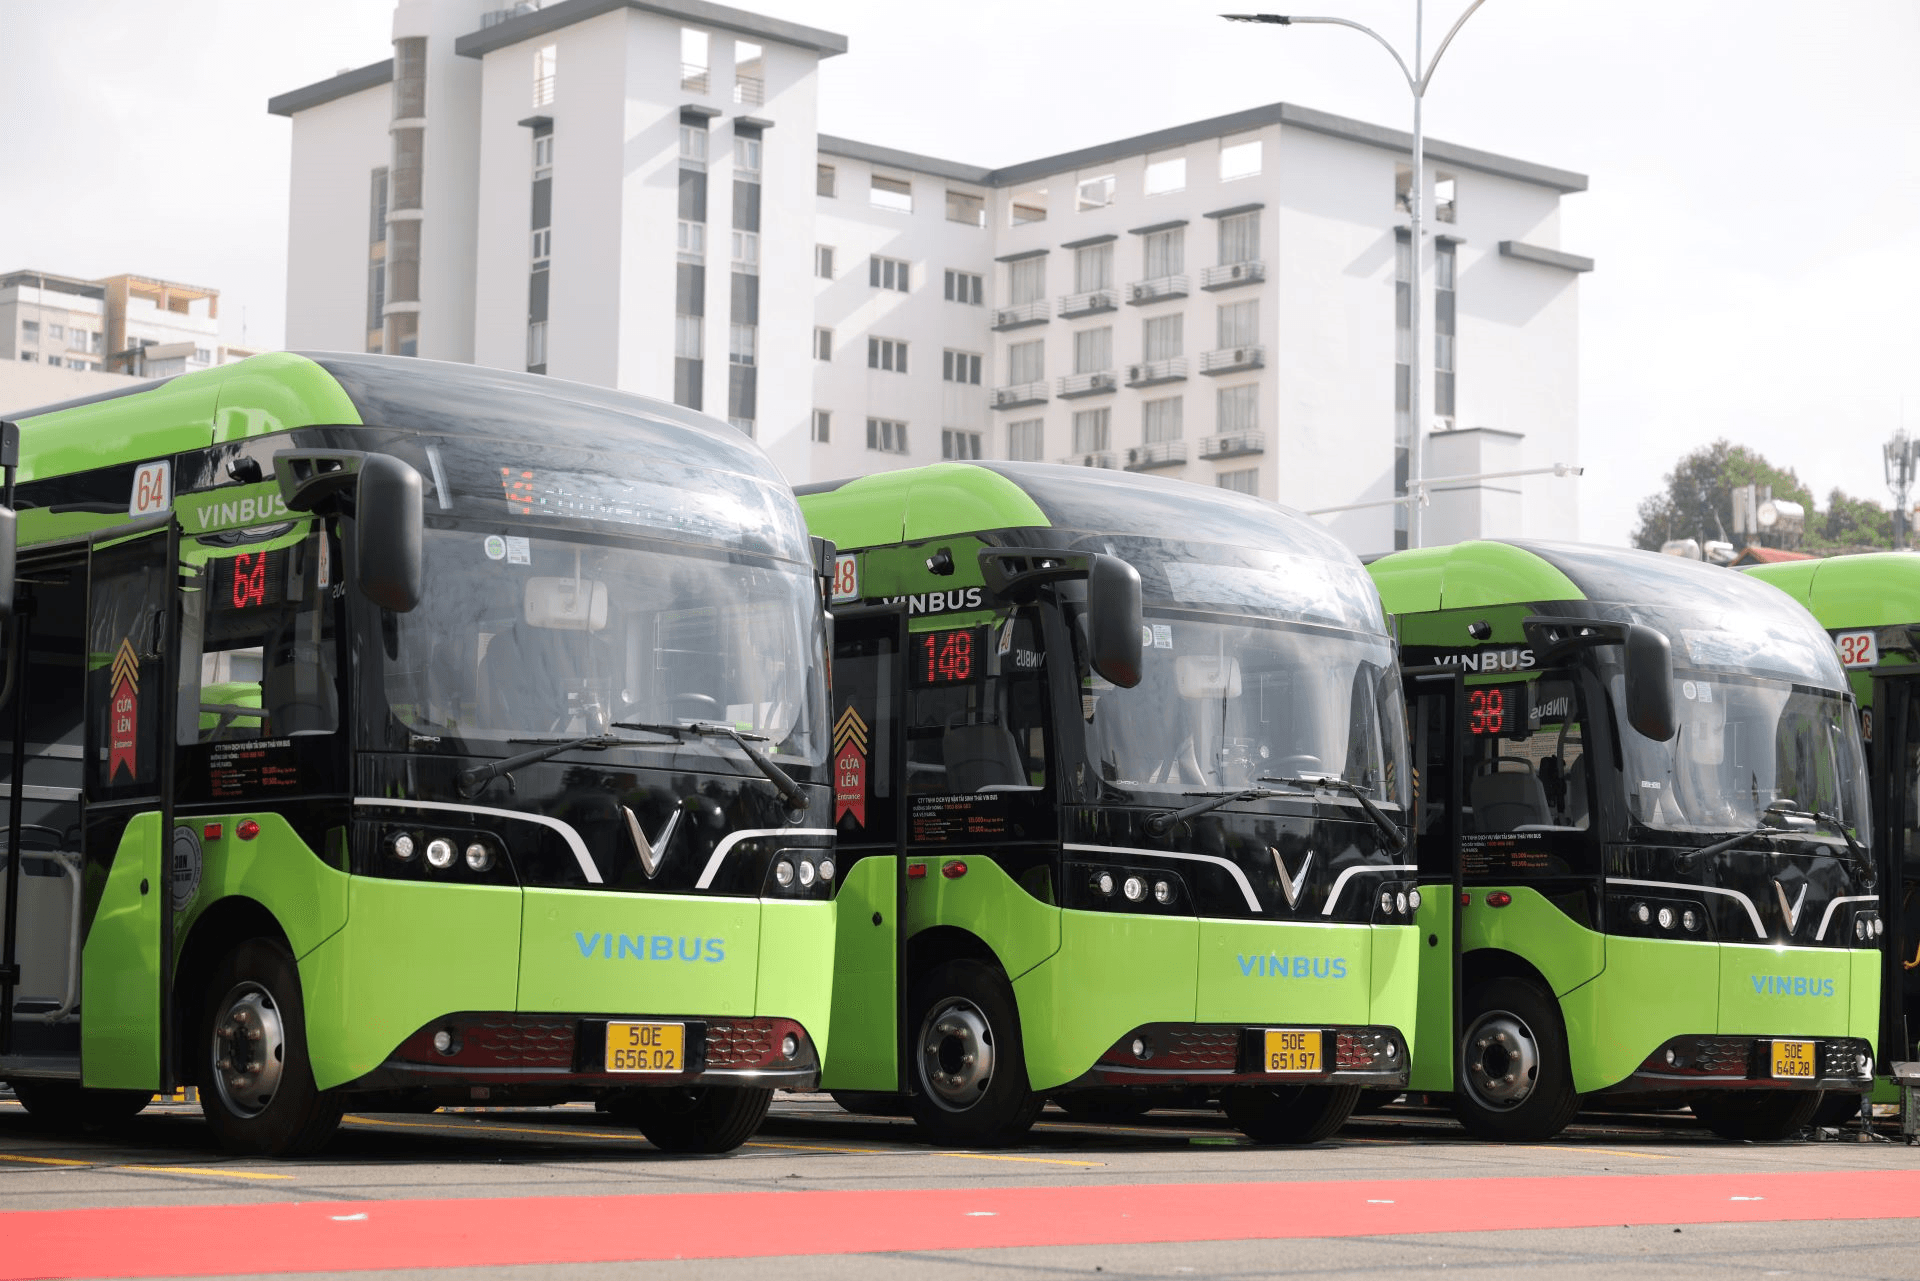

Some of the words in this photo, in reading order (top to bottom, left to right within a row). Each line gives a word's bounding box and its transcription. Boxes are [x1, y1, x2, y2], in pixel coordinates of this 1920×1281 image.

[137, 467, 163, 511] 64
[197, 493, 290, 529] VINBUS
[233, 550, 266, 608] 64
[924, 630, 971, 683] 148
[1841, 636, 1871, 665] 32
[1469, 688, 1503, 734] 38
[840, 754, 860, 769] CỬA
[841, 772, 859, 787] LÊN
[575, 932, 726, 963] VINBUS
[1237, 954, 1348, 978] VINBUS
[1751, 975, 1835, 997] VINBUS
[629, 1026, 661, 1046] 50E
[1281, 1033, 1305, 1050] 50E
[614, 1049, 675, 1070] 656.02
[1271, 1053, 1316, 1070] 651.97
[1784, 1044, 1802, 1059] 50E
[1776, 1060, 1810, 1076] 648.28
